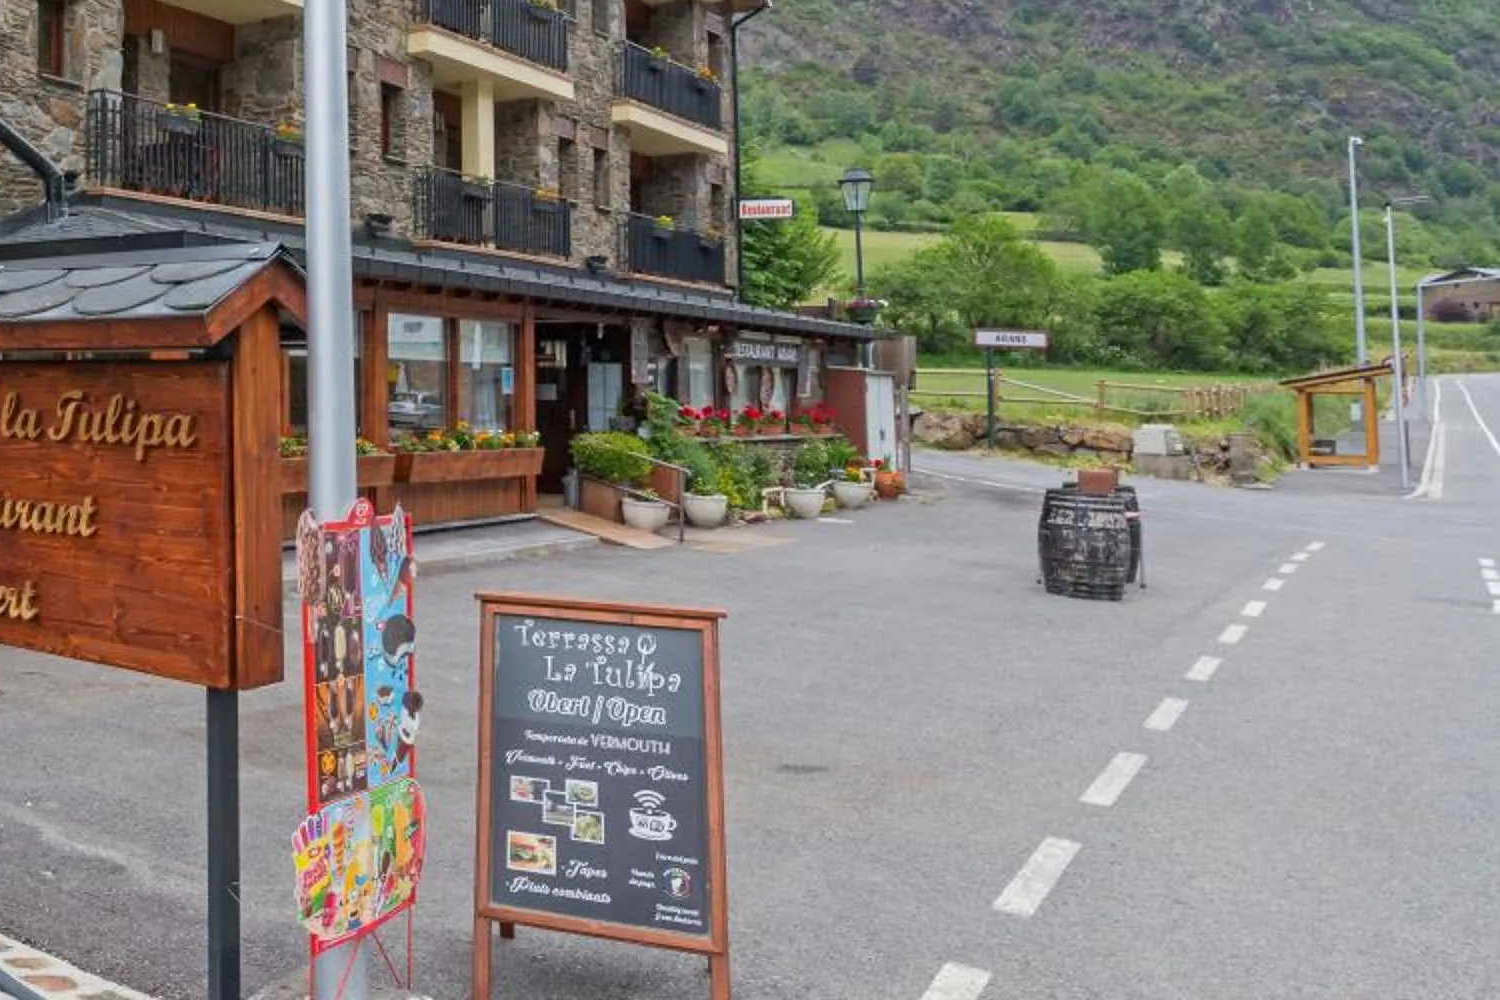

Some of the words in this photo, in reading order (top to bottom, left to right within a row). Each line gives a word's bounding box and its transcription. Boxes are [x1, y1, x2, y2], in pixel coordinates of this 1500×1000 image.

[1, 391, 42, 438] la
[48, 389, 198, 461] Tulipa
[514, 619, 630, 655] Terrassa
[543, 655, 577, 683] La
[585, 656, 681, 696] Tulipa
[528, 688, 590, 718] Obert
[606, 696, 666, 727] Open
[590, 733, 671, 755] VERMOUTH
